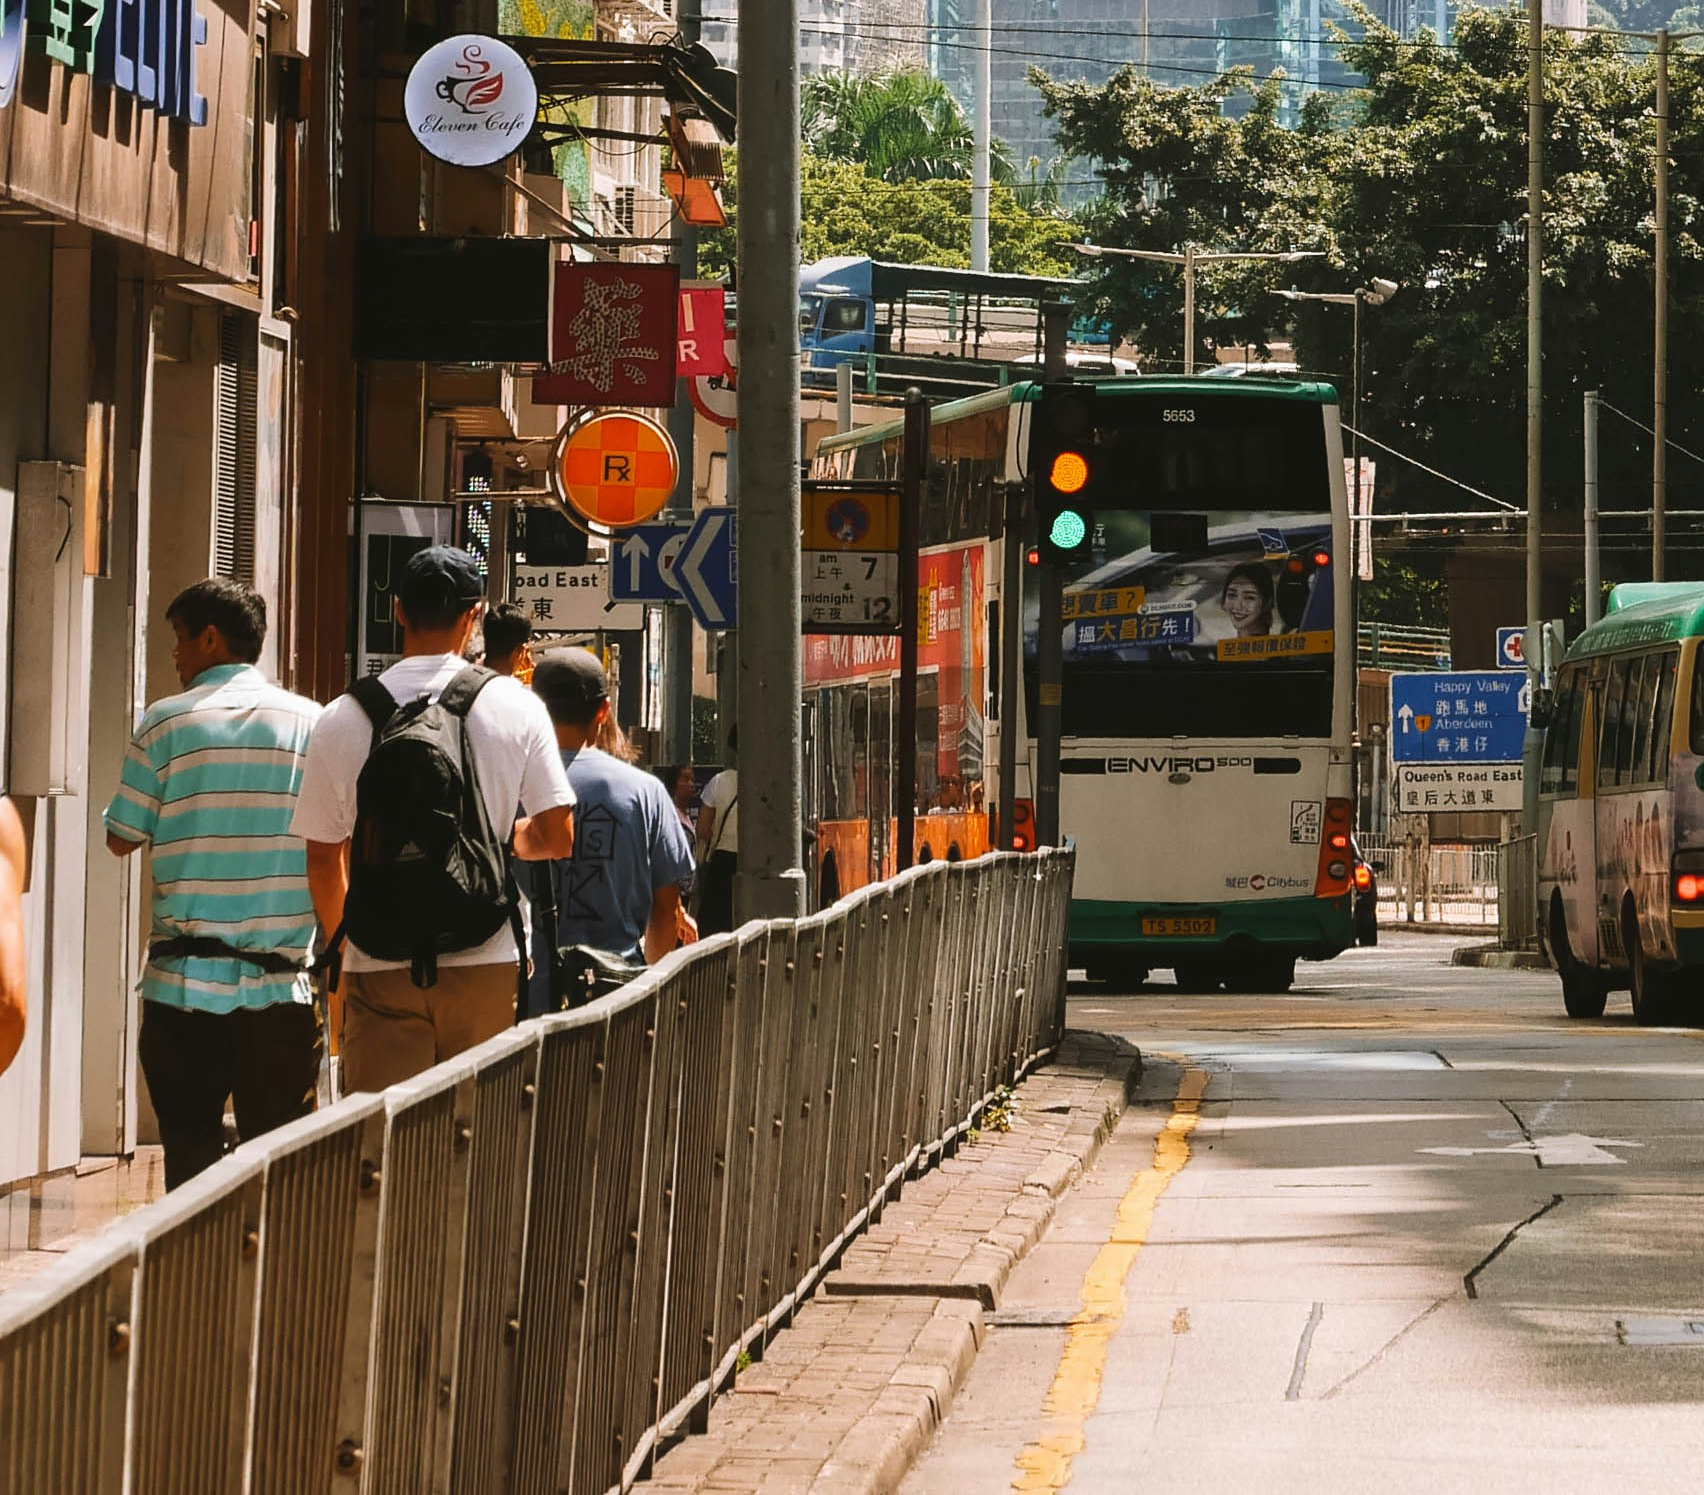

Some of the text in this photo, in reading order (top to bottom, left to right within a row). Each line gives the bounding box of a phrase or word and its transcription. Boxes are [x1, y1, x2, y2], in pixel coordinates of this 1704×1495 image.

[418, 113, 478, 134] Eleven
[1162, 409, 1195, 423] 5653
[813, 566, 843, 580] 上午
[819, 554, 878, 581] am 7
[515, 572, 599, 588] oad East
[801, 593, 892, 621] midnight 12
[1434, 680, 1511, 694] Happy Valley
[1435, 699, 1488, 716] 跑馬地
[1435, 717, 1494, 730] Aberdeen
[1436, 736, 1488, 752] 香港仔
[1106, 757, 1252, 774] ENVIRO 500
[1404, 769, 1523, 782] Queen's Road East
[1406, 789, 1495, 806] 皇后大道東
[1267, 875, 1310, 889] Citybus
[1147, 919, 1167, 933] TS
